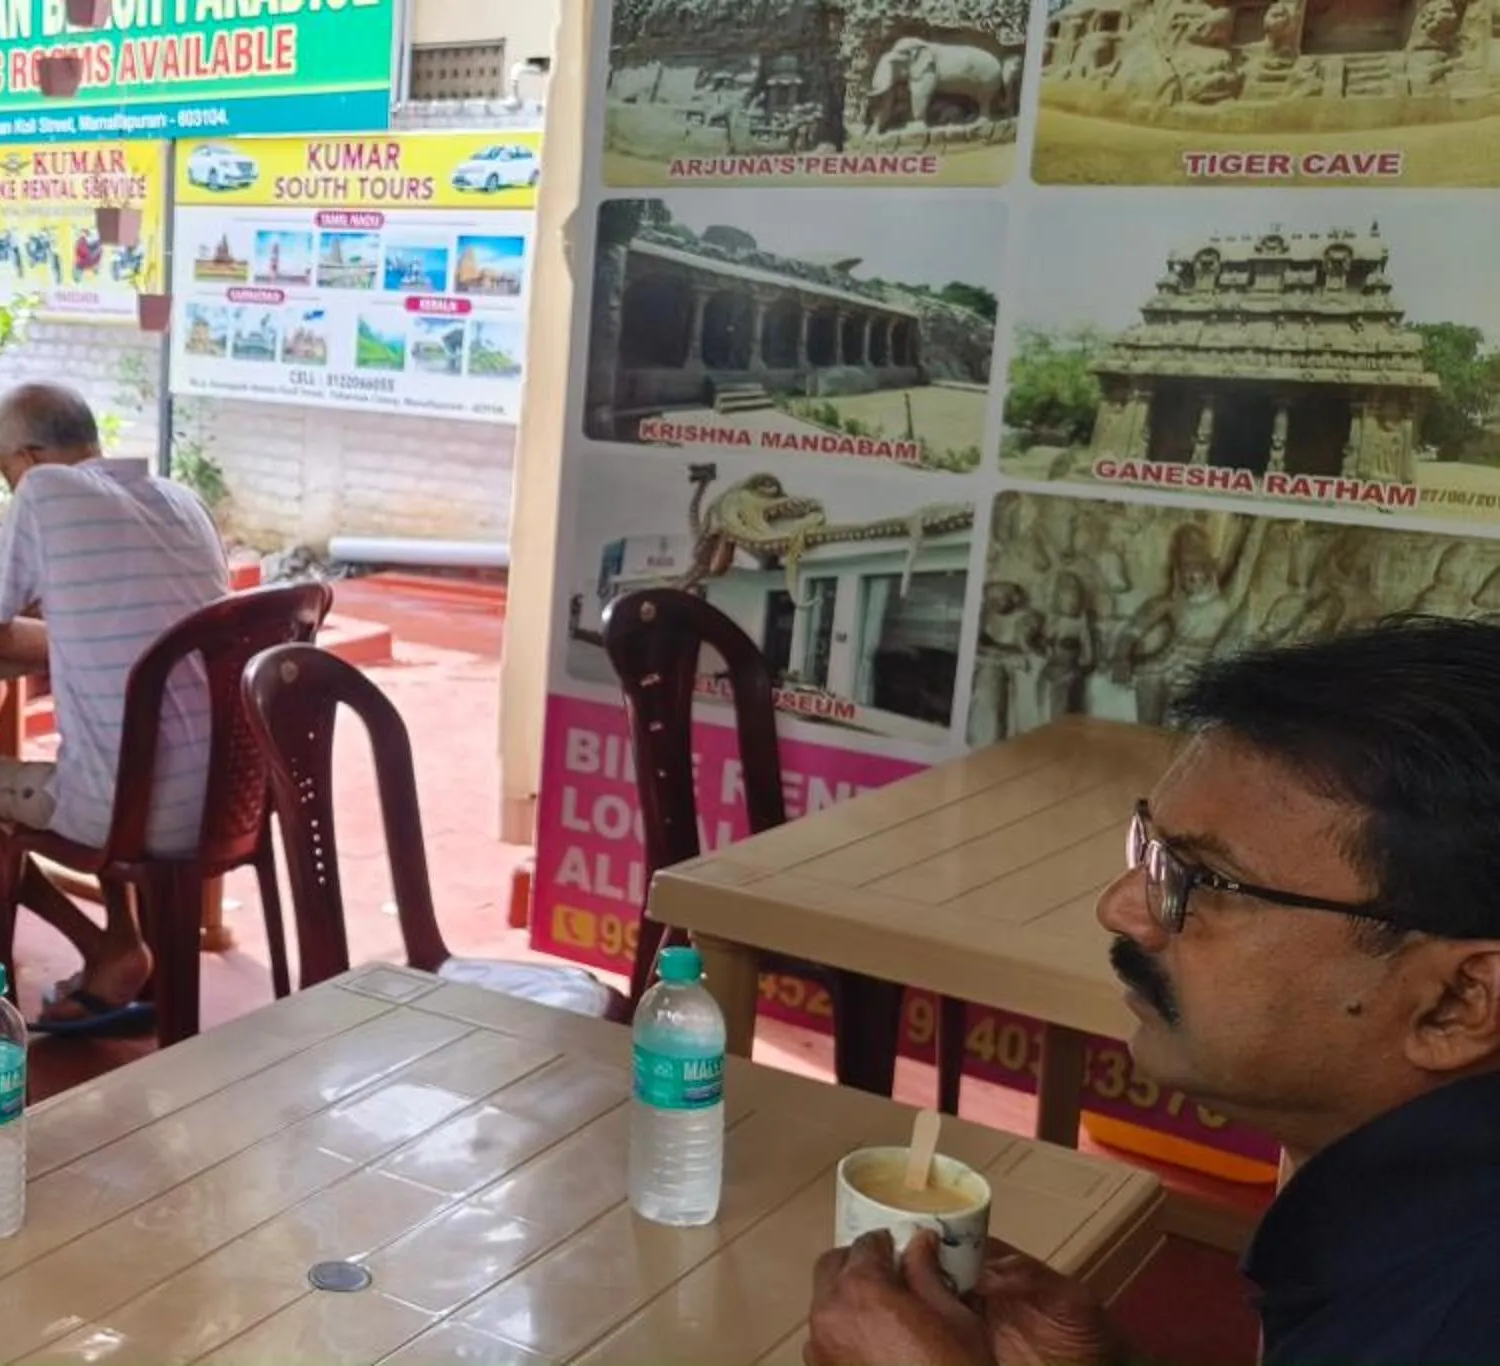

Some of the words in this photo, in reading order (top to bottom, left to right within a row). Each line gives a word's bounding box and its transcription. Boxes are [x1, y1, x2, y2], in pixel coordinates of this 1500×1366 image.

[120, 28, 294, 81] AVAILABLE
[33, 150, 126, 175] KUMAR
[307, 142, 401, 171] KUMAR
[804, 155, 938, 175] PENANCE
[1186, 153, 1291, 175] TIGER
[1302, 153, 1400, 175] CAVE
[22, 178, 78, 200] RENTAL
[82, 175, 147, 200] SERVICE
[274, 175, 349, 200] SOUTH
[358, 176, 435, 200] TOURS
[640, 421, 752, 446] KRISHNA
[760, 430, 918, 461] MANDABAM
[1095, 459, 1253, 492] GANESHA
[1266, 471, 1418, 507] RATHAM
